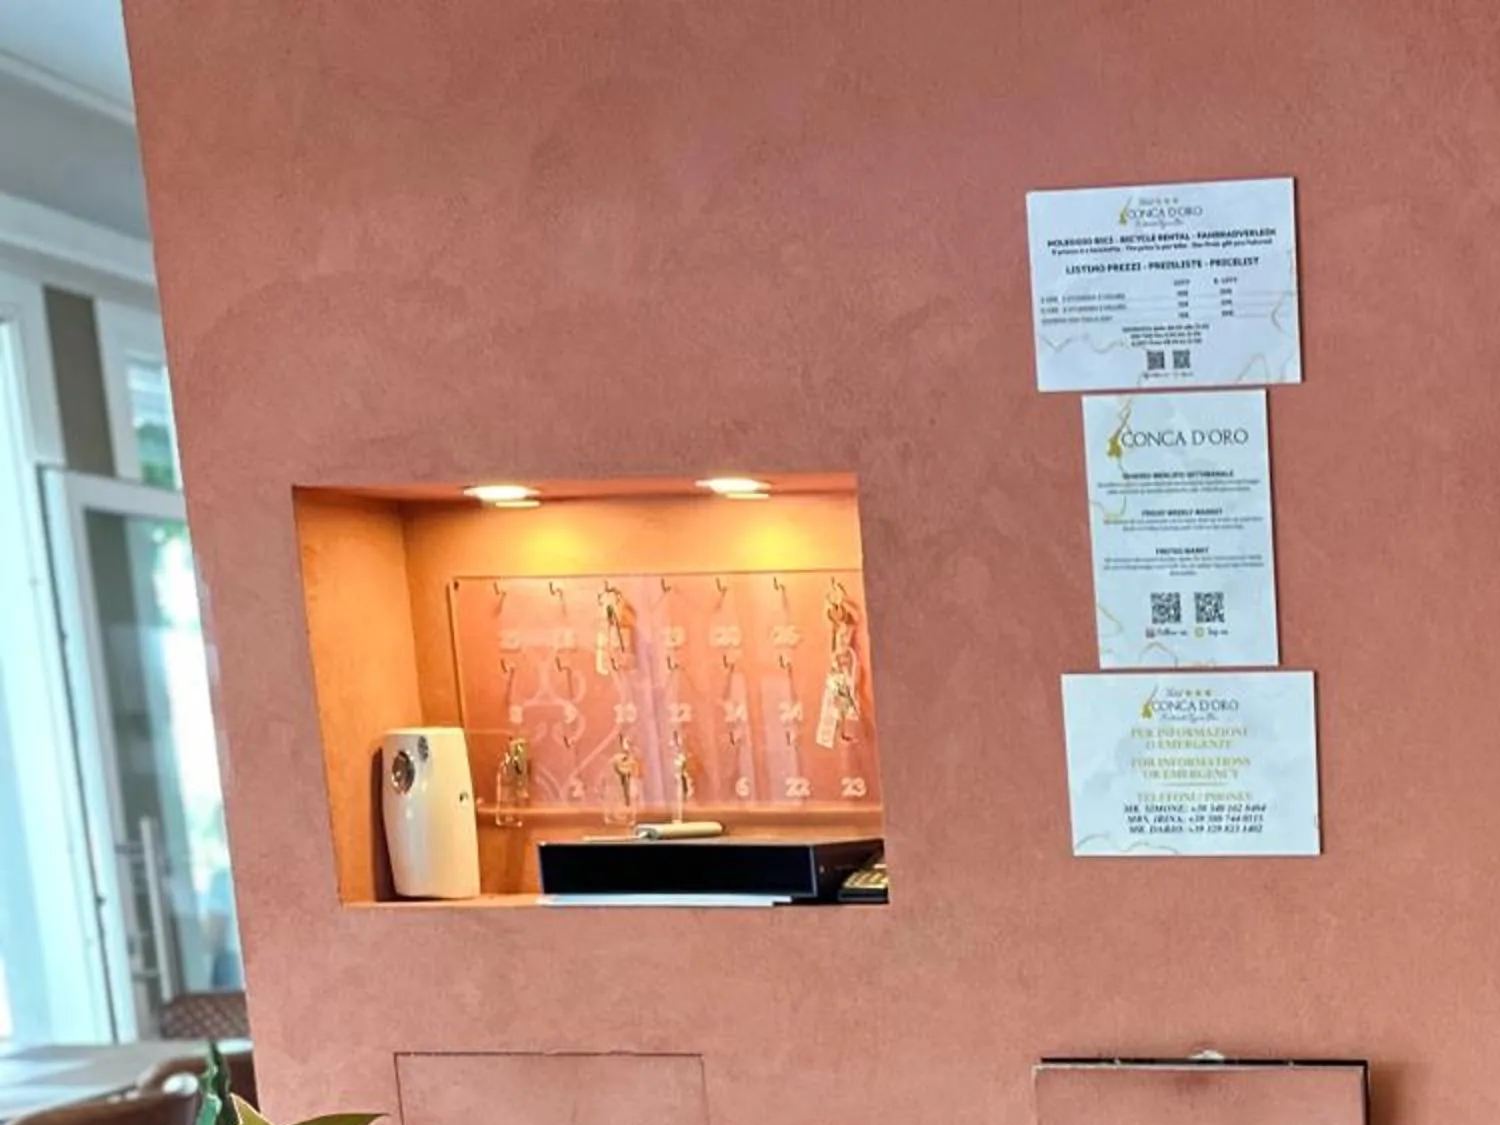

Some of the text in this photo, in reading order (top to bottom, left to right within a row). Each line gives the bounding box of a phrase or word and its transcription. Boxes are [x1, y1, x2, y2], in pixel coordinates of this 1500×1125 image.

[1121, 428, 1249, 448] CONCA D'ORO
[1151, 699, 1197, 712] CONCA
